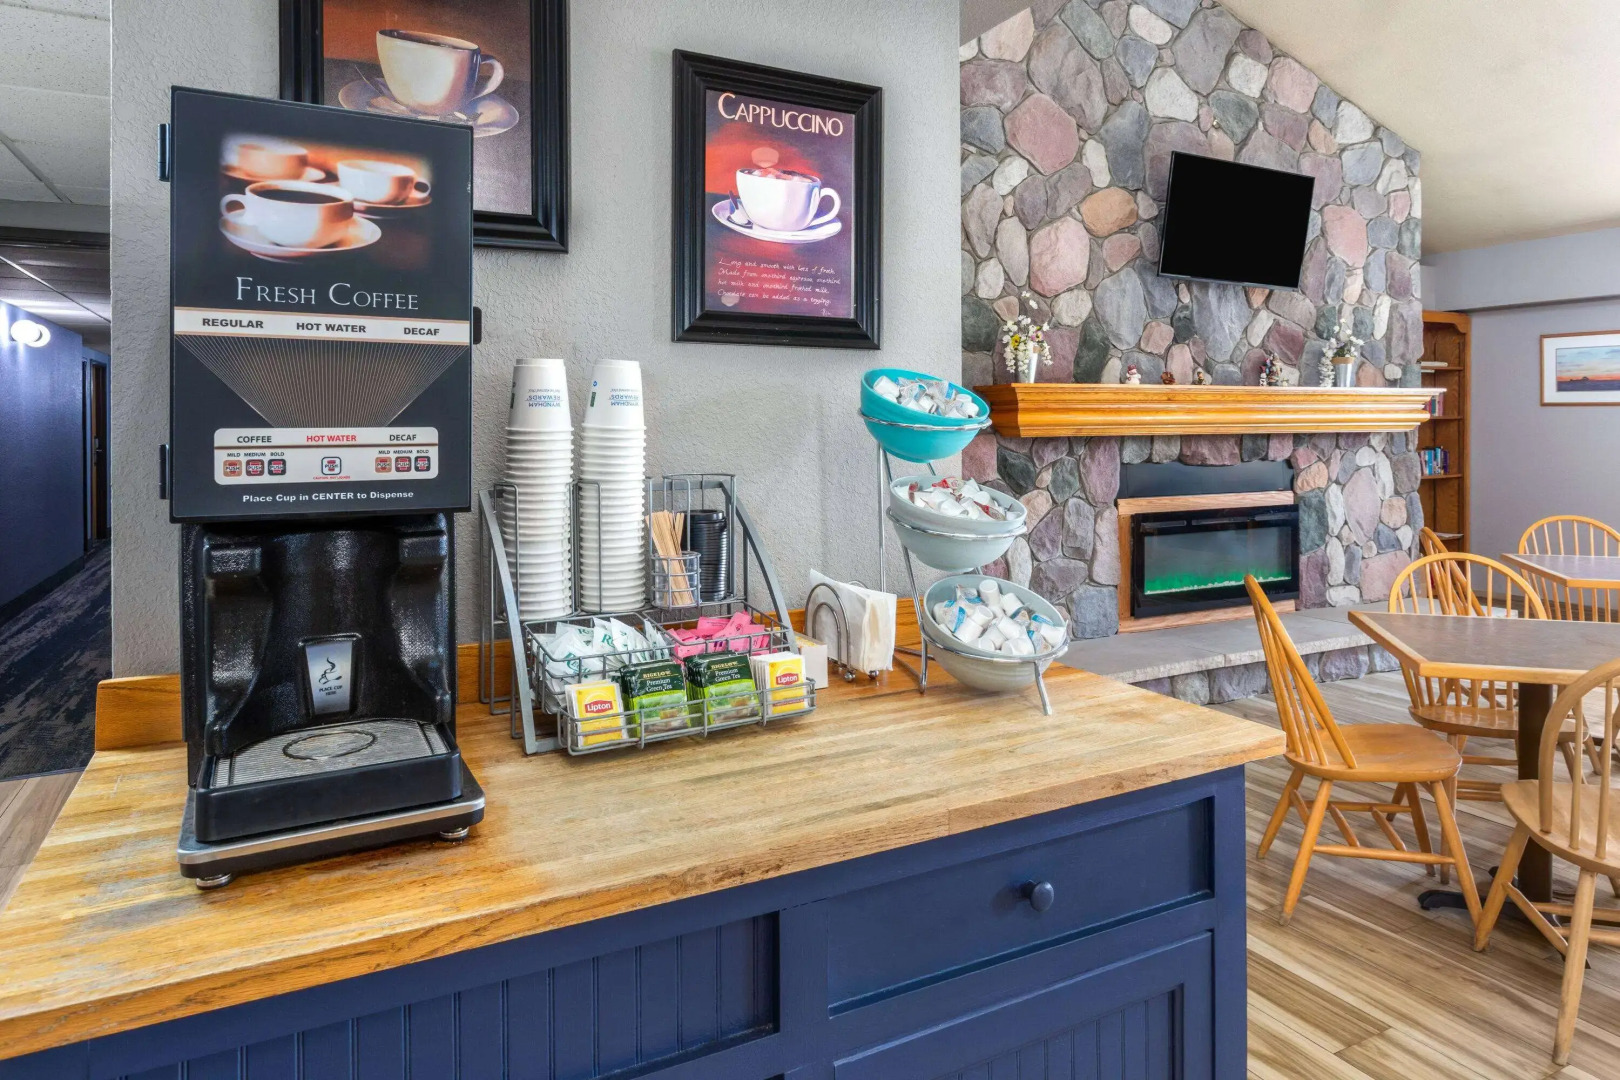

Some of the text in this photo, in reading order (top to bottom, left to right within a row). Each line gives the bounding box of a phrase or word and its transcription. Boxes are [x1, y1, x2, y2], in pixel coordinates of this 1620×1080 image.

[717, 91, 844, 137] CAPPUCCINO
[718, 267, 740, 276] Made
[742, 269, 757, 279] from
[202, 317, 264, 329] REGULAR
[296, 322, 367, 333] HOT WATER
[403, 326, 441, 337] DECAF
[236, 435, 273, 444] COFFEE
[306, 434, 357, 443] HOT WATER
[389, 433, 418, 442] DECAF
[242, 495, 273, 503] Place
[275, 494, 297, 503] Cup
[311, 492, 354, 501] CENTER
[357, 491, 367, 499] to
[370, 491, 414, 500] Dispense
[711, 661, 738, 669] BIGELOW
[715, 668, 739, 677] Premium
[646, 678, 671, 687] Premium
[715, 675, 731, 683] Green
[777, 675, 798, 683] Lipton
[646, 685, 663, 693] Green
[587, 703, 611, 712] Lipton
